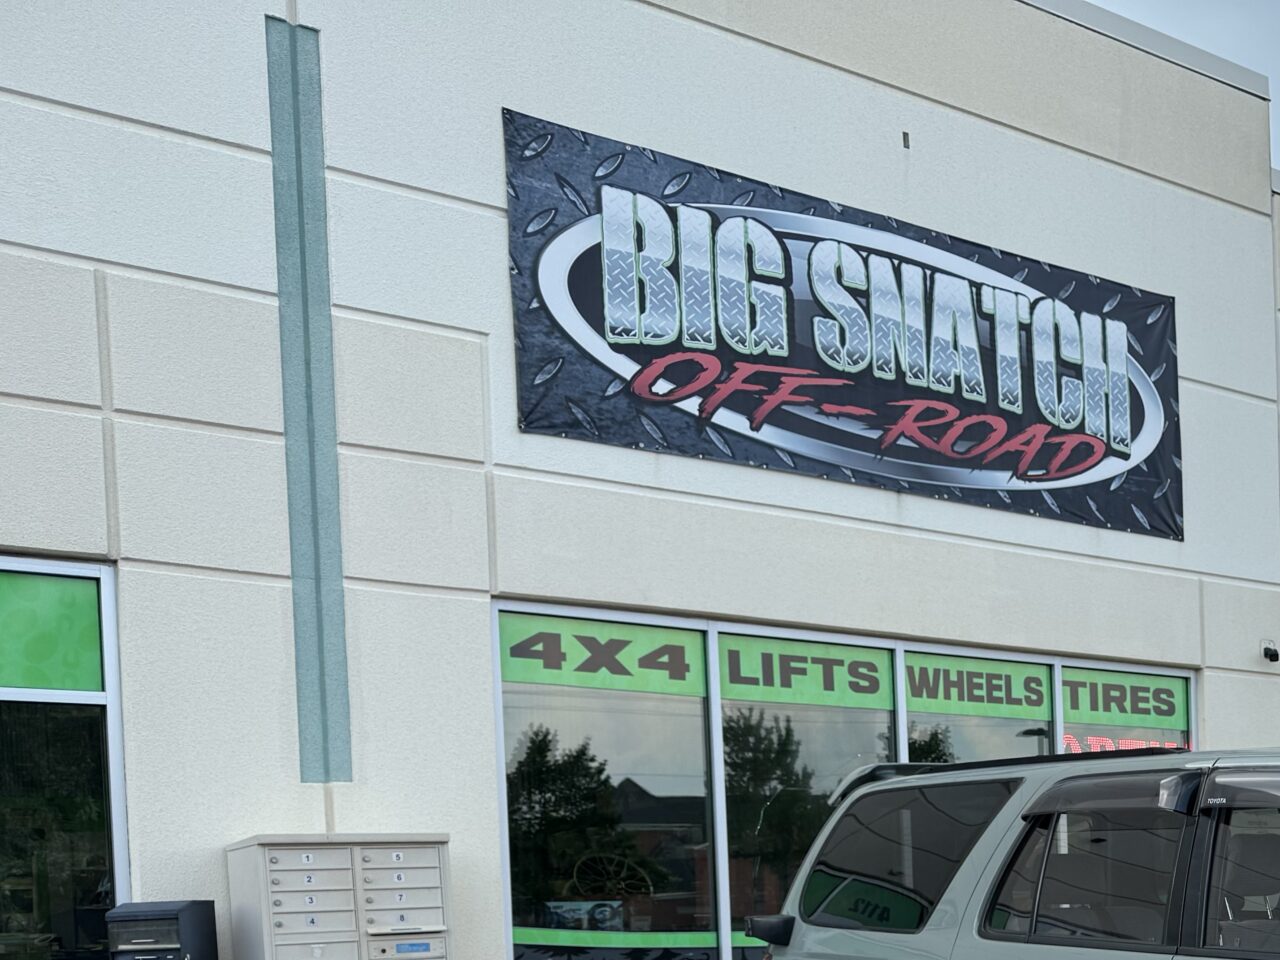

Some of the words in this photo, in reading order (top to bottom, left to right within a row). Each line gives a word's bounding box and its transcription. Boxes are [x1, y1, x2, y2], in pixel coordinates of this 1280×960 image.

[599, 183, 791, 358] BIG
[807, 238, 1132, 457] SNATCH
[630, 351, 1106, 481] OFF-ROAD
[509, 631, 691, 681] 4X4
[727, 649, 880, 695] LIFTS
[906, 665, 1045, 707] WHEELS
[1062, 679, 1176, 717] TIRES
